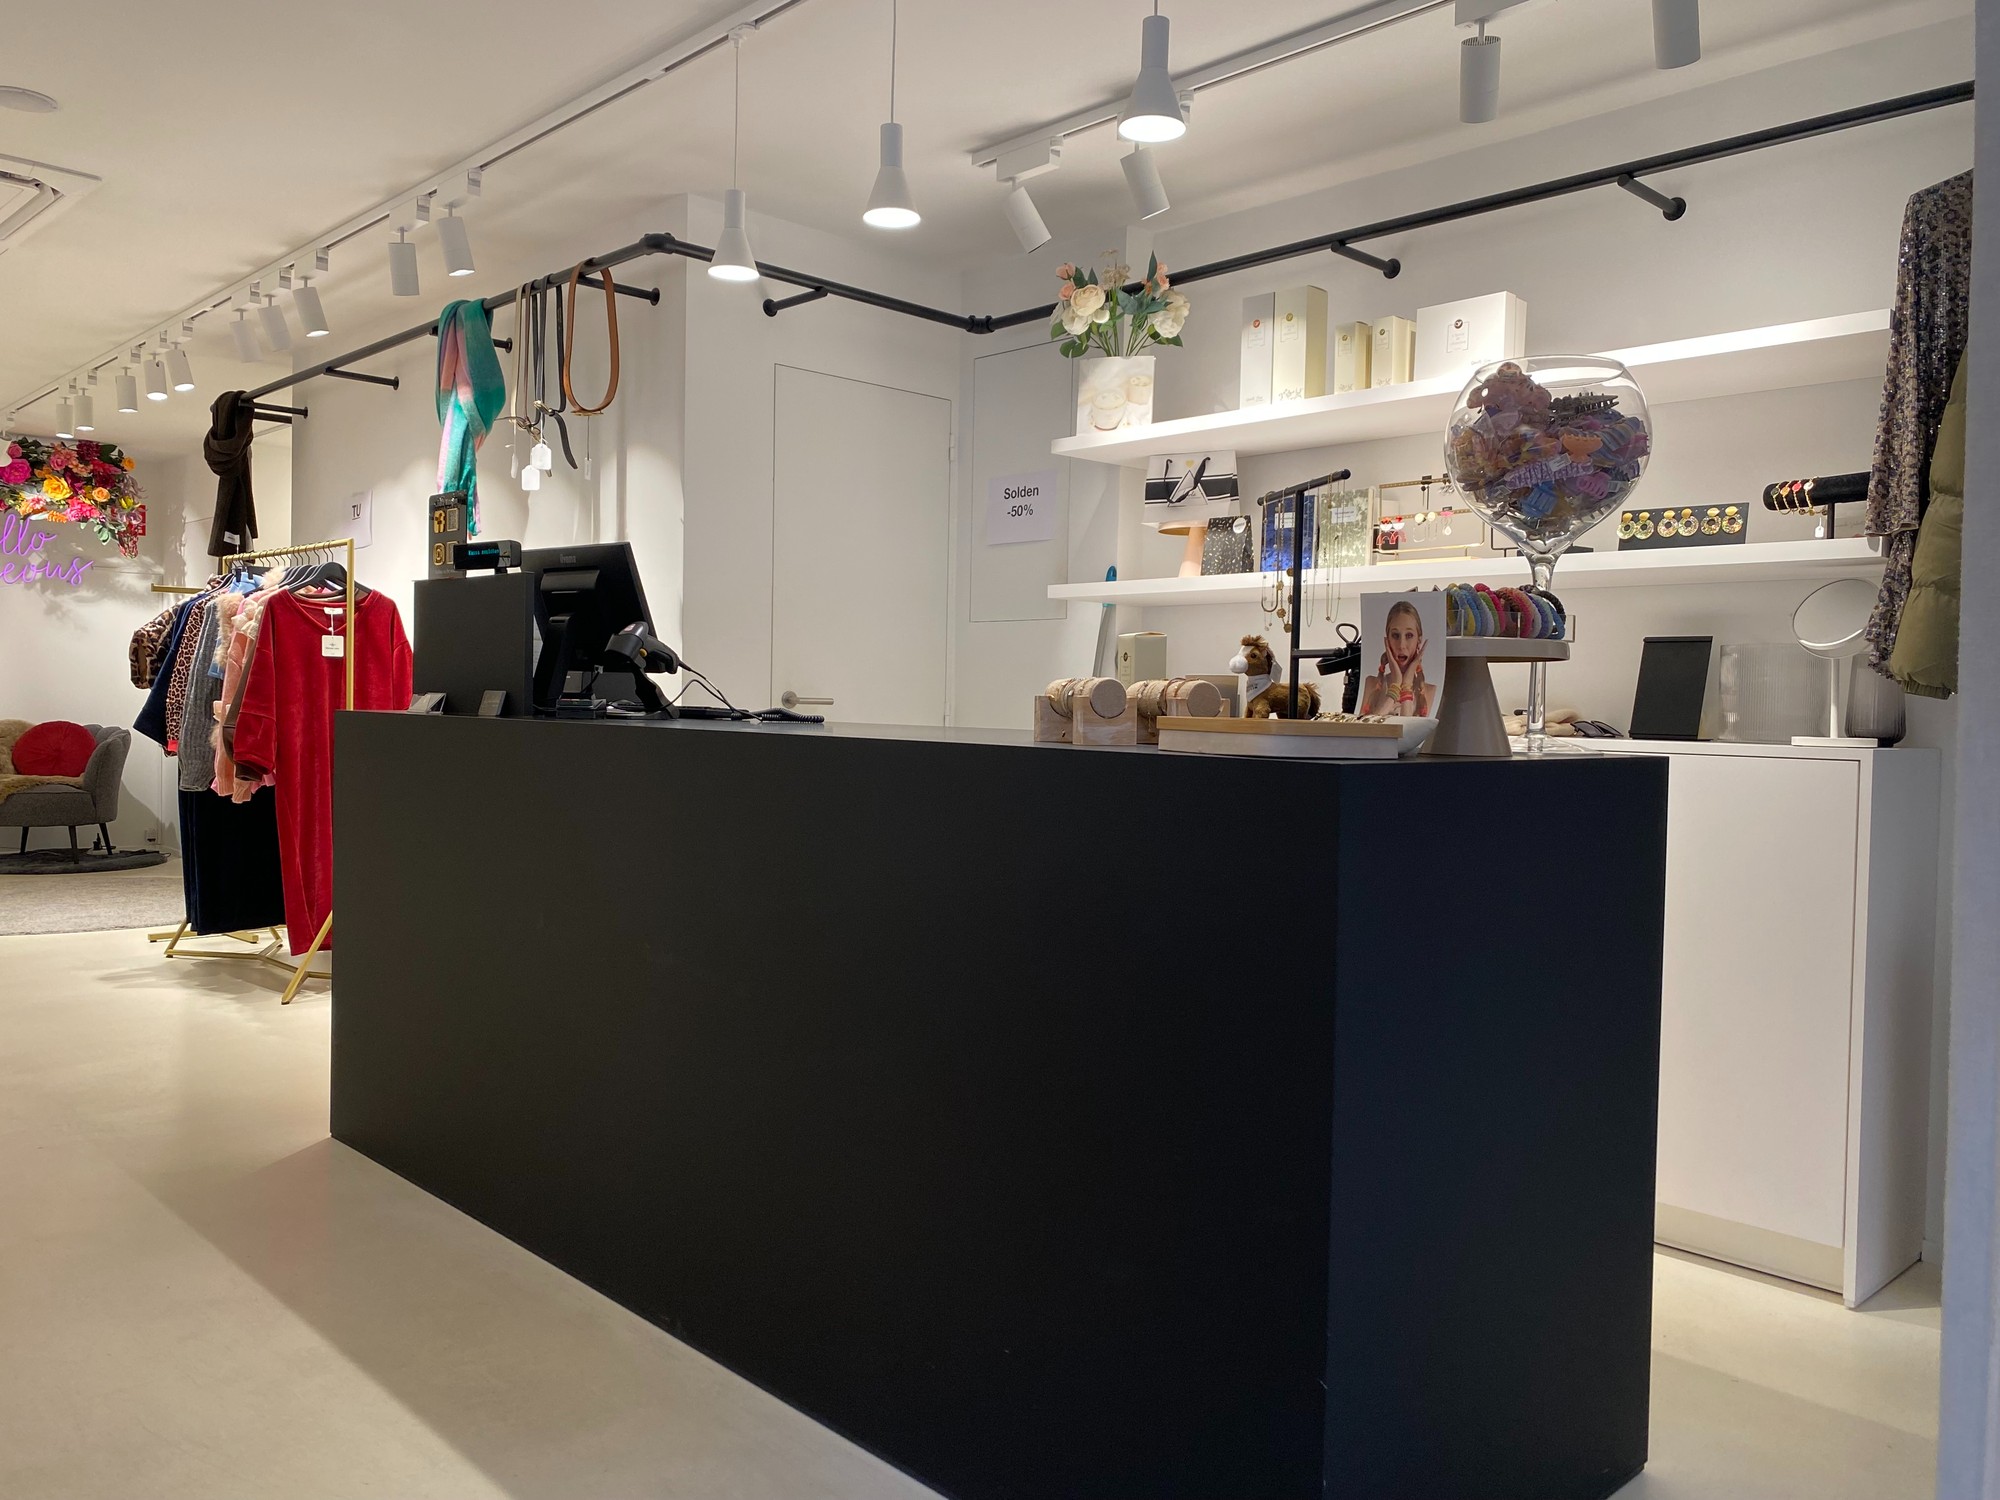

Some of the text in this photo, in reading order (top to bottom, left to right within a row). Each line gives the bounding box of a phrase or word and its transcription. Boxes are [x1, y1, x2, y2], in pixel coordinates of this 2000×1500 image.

[1003, 485, 1040, 500] Solden
[351, 503, 362, 518] TU
[1006, 503, 1034, 518] -50%
